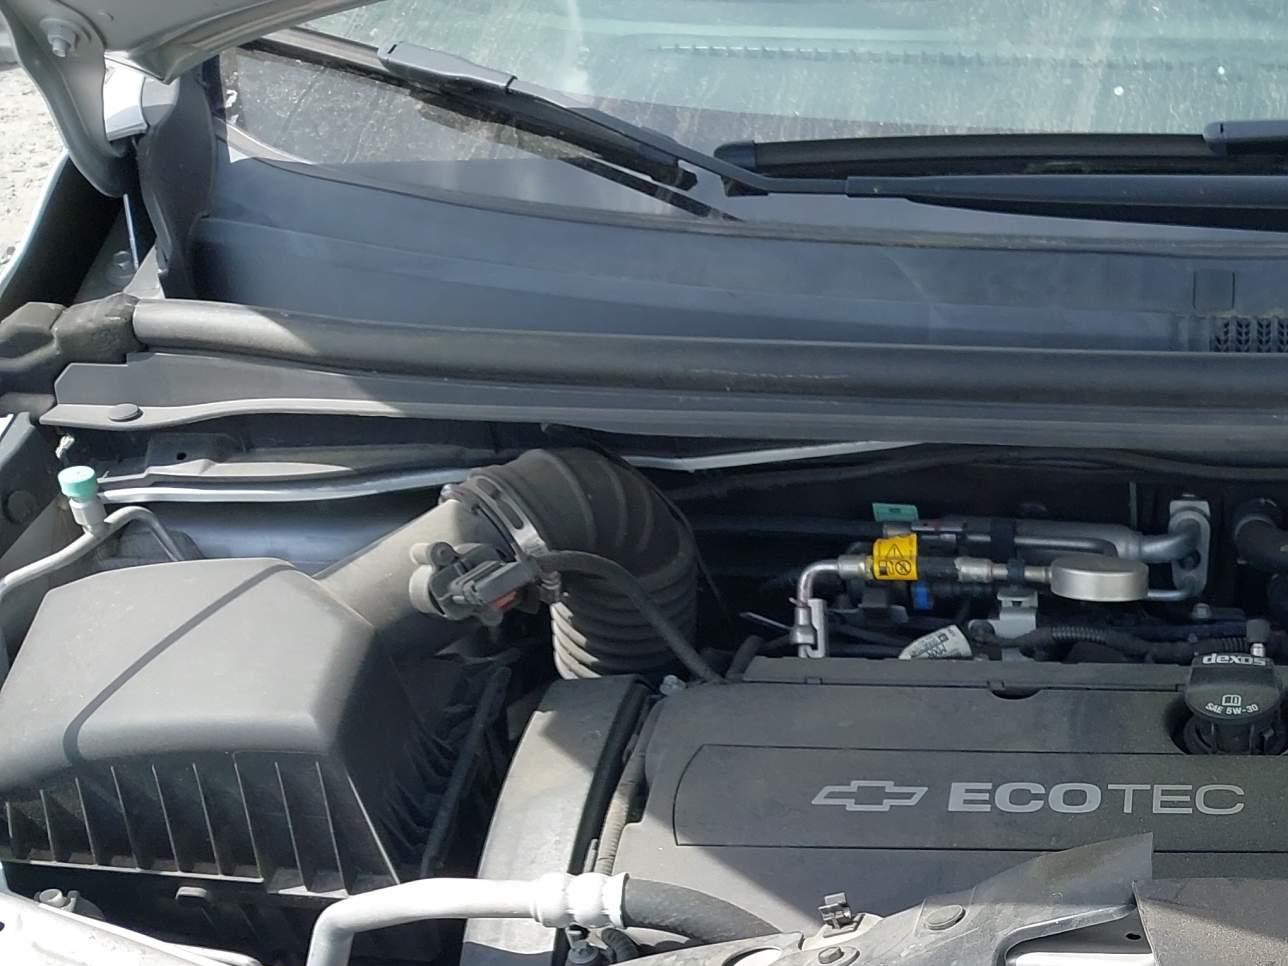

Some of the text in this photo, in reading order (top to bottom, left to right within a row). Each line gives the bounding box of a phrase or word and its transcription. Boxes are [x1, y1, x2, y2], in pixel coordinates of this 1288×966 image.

[1202, 653, 1266, 666] dexos
[1205, 702, 1259, 715] SAE 5W-30
[947, 781, 1246, 815] ECOTEC
